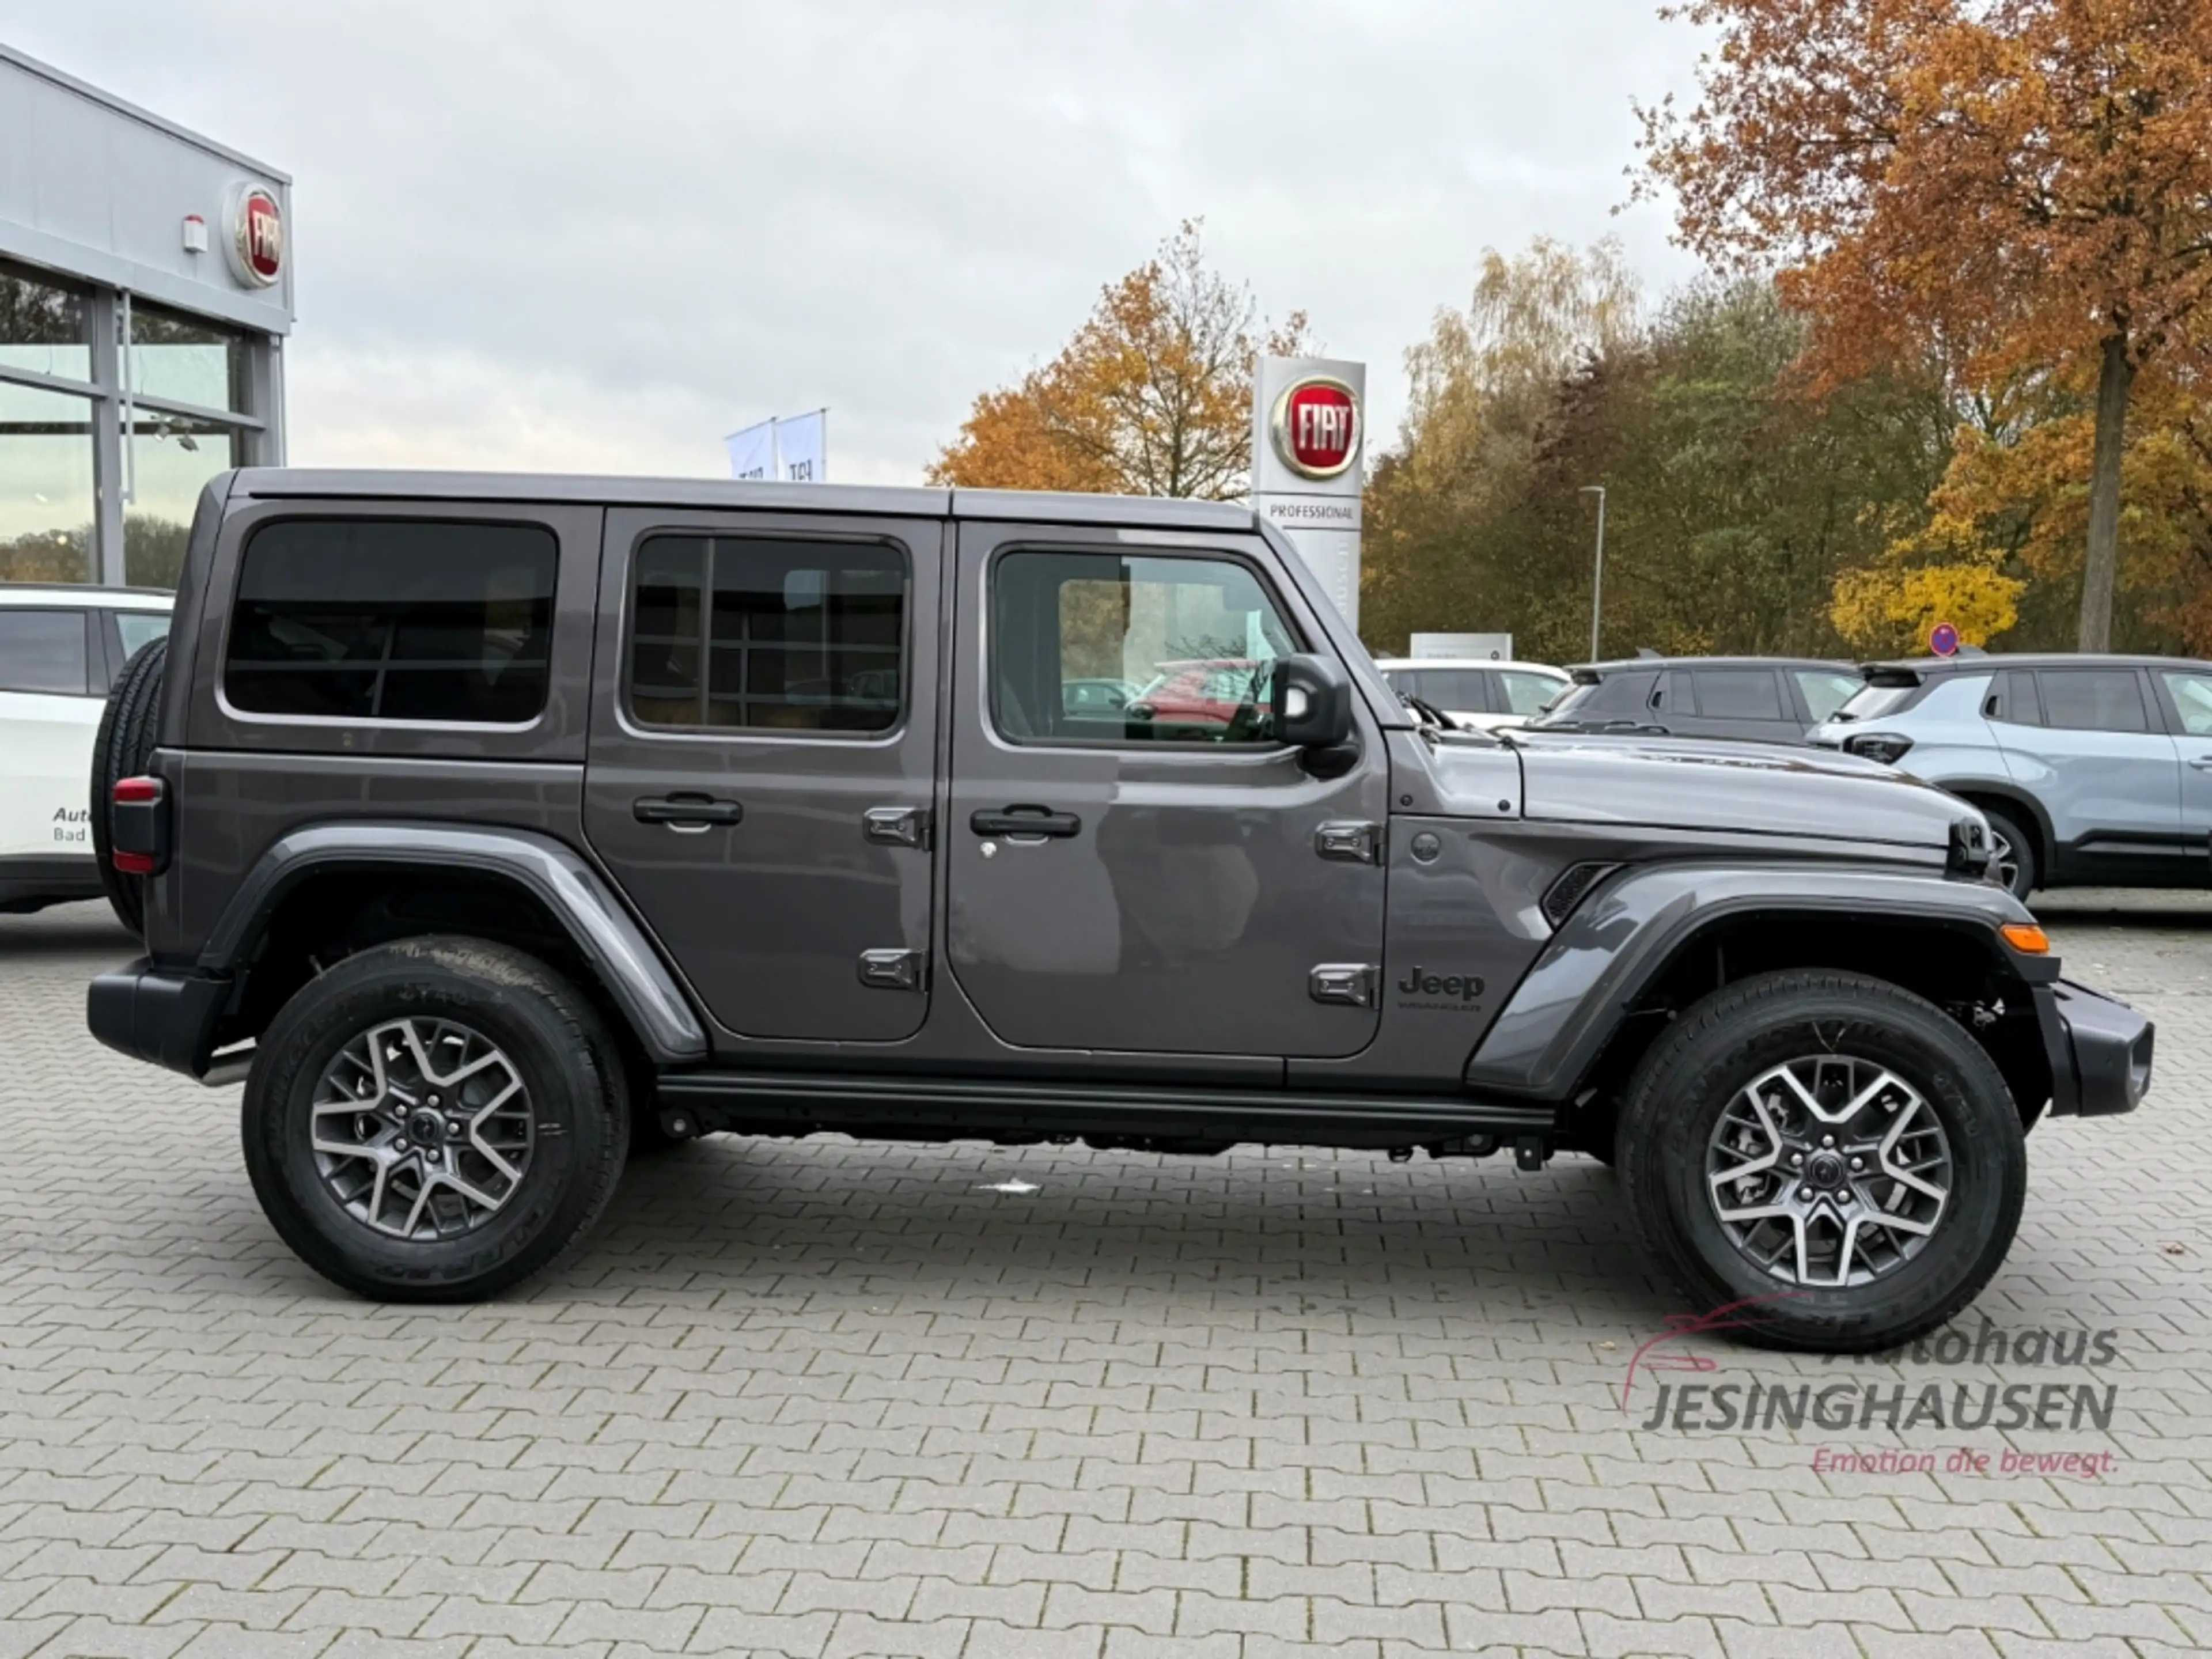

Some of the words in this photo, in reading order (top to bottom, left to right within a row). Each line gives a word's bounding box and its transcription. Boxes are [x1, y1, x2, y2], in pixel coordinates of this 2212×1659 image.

[252, 210, 281, 262] FIAT
[1298, 403, 1350, 452] FIAT
[1270, 504, 1354, 520] PROFESSIONAL
[54, 827, 85, 841] Bad
[1398, 965, 1484, 1001] Jeep
